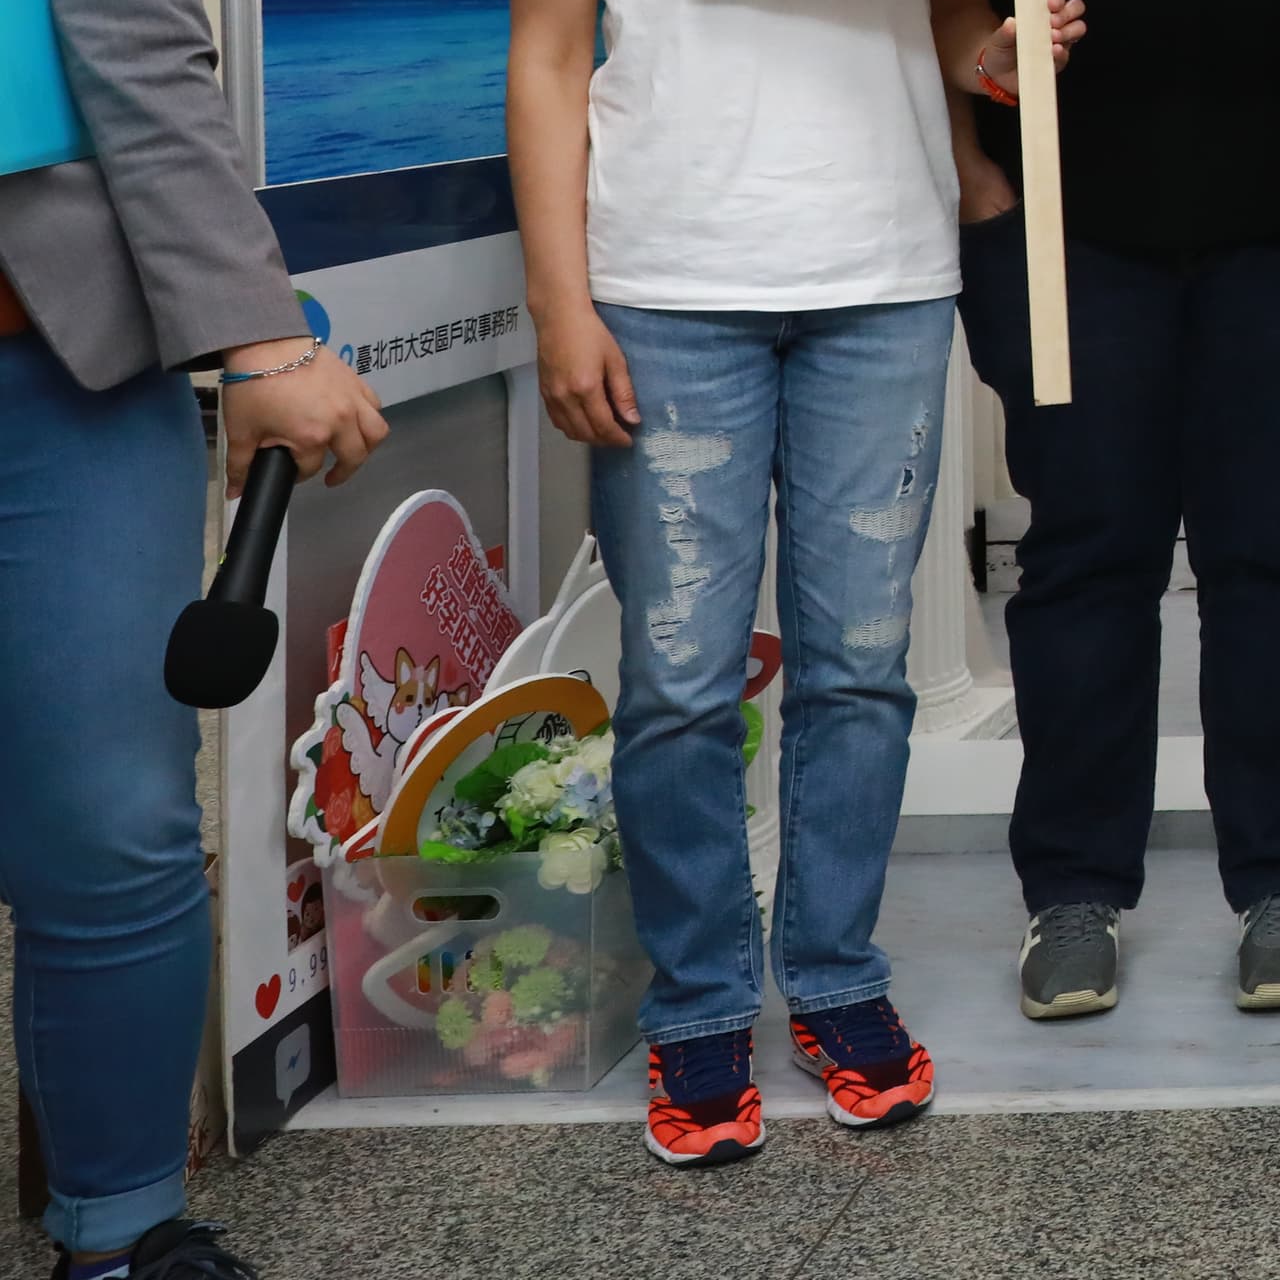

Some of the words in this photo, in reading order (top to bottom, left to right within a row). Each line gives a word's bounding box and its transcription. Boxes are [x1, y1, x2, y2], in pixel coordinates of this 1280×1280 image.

[356, 305, 519, 375] 臺北市大安區戶政事務所
[420, 565, 497, 691] 好孕旺旺
